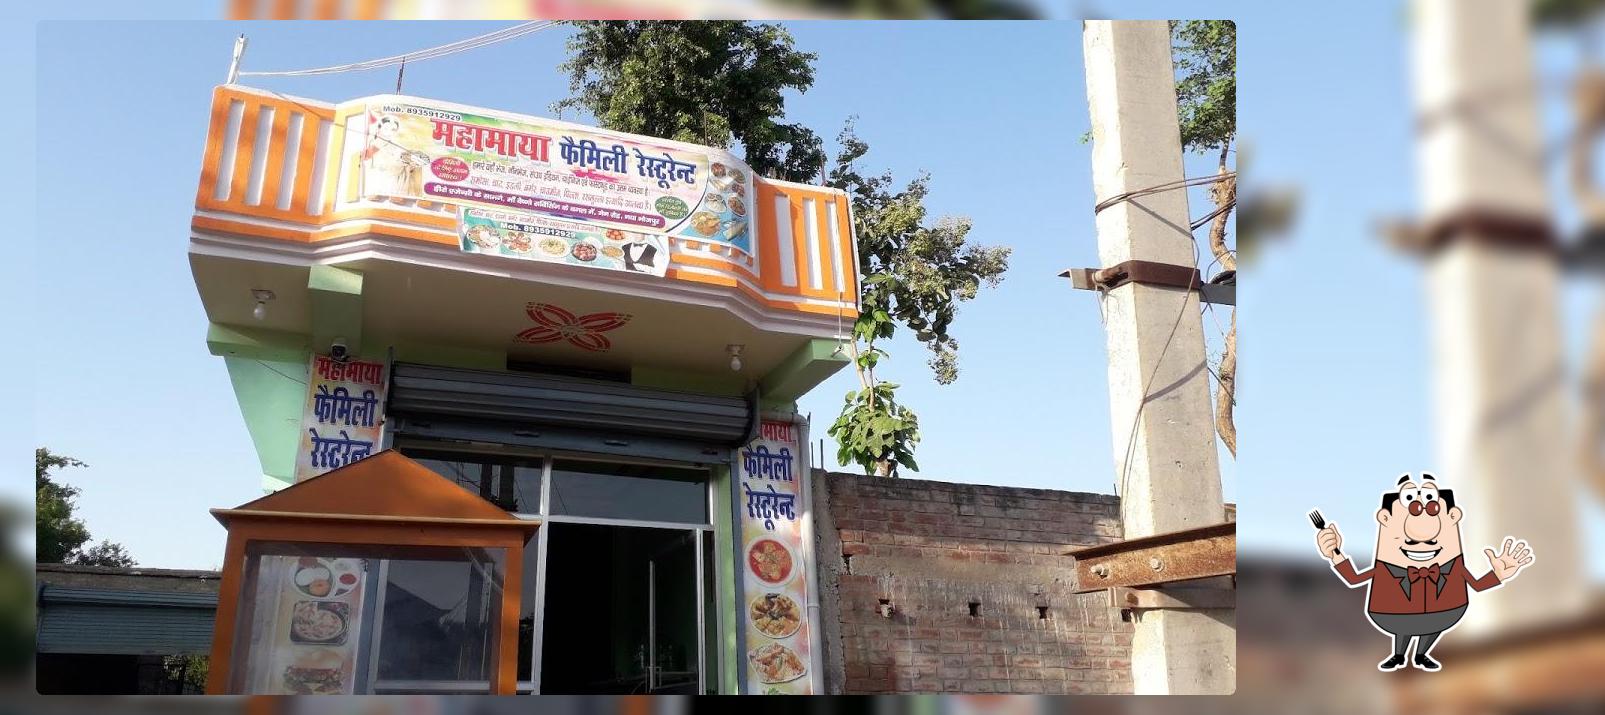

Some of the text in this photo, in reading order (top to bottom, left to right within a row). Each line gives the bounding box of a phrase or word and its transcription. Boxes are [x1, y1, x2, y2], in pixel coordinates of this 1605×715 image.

[383, 105, 461, 122] Mob. 8935912929
[430, 118, 696, 189] महामाया फैमिली रेस्टूरेन्ट
[500, 223, 521, 231] Mob.
[314, 384, 379, 427] फैमिली
[742, 444, 793, 481] फैमिली
[743, 482, 796, 530] रेस्टूरेन्ट
